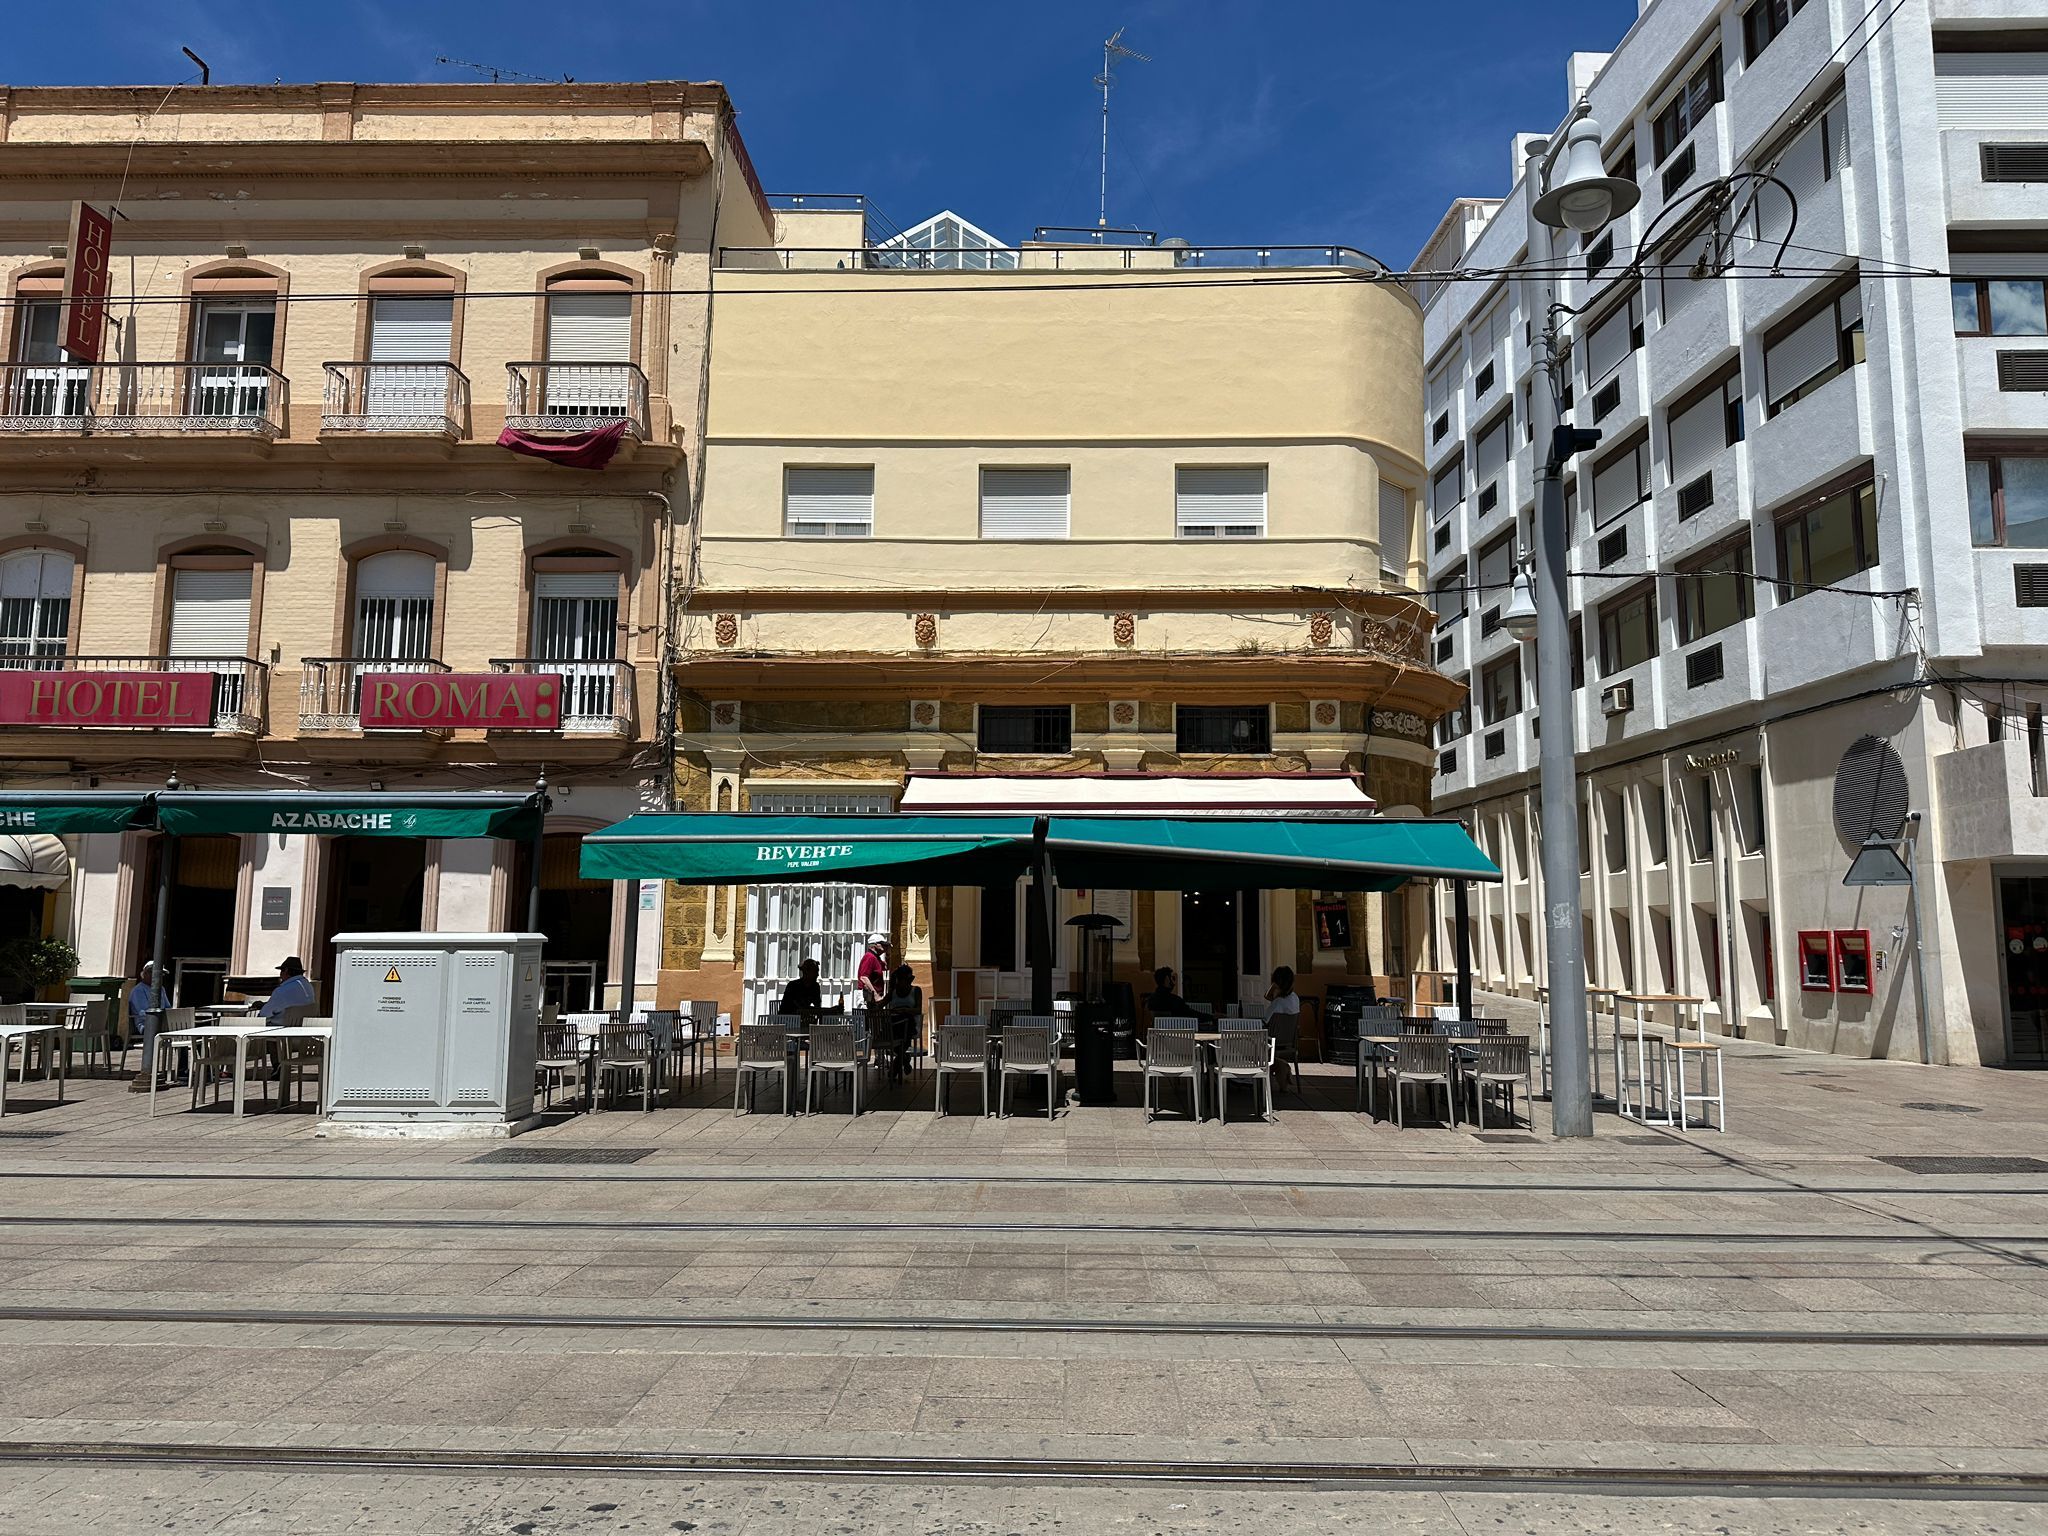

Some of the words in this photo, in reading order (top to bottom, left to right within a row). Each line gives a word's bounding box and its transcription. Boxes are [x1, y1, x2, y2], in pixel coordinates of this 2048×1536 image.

[77, 218, 105, 346] HOTEL
[28, 679, 194, 718] HOTEL
[271, 812, 392, 829] AZABACHE
[756, 845, 854, 861] REVERTE
